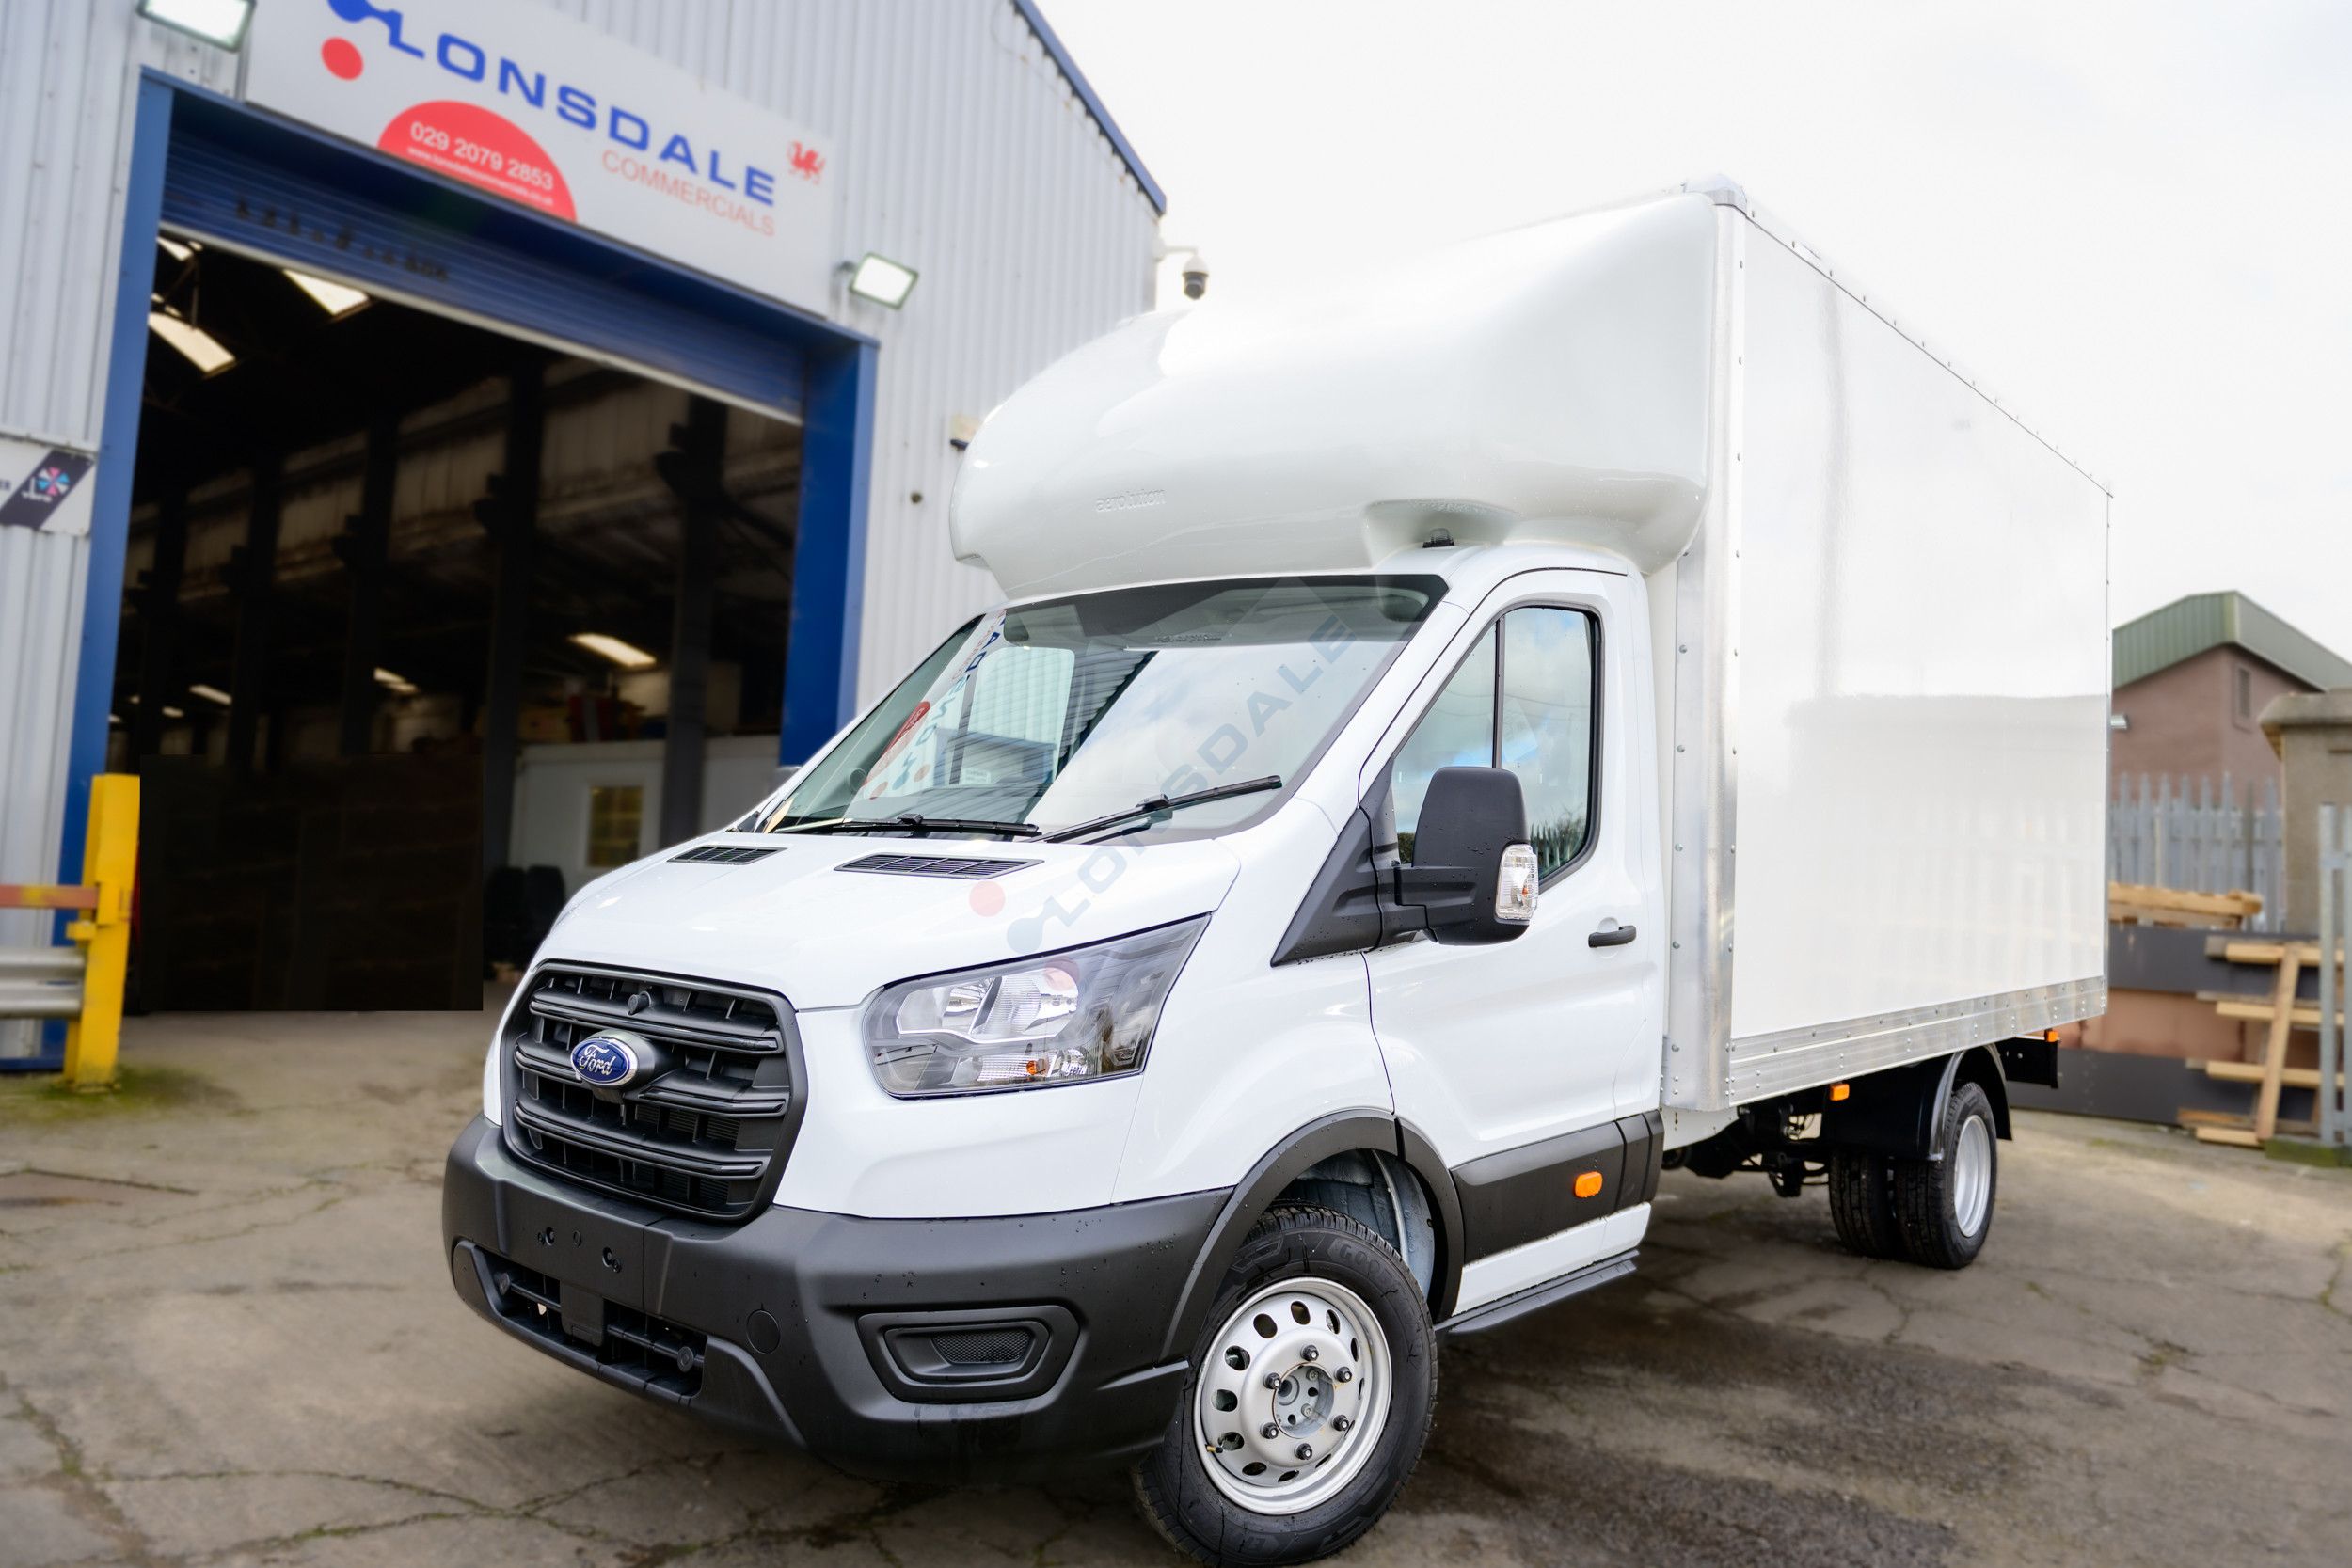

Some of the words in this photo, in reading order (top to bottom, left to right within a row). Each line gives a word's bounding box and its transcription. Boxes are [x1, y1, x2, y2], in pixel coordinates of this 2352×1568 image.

[388, 9, 775, 207] LONSDALE
[408, 120, 450, 152] 029
[453, 138, 503, 171] 2079
[601, 149, 775, 237] COMMERCIALS
[579, 1044, 617, 1075] Ford
